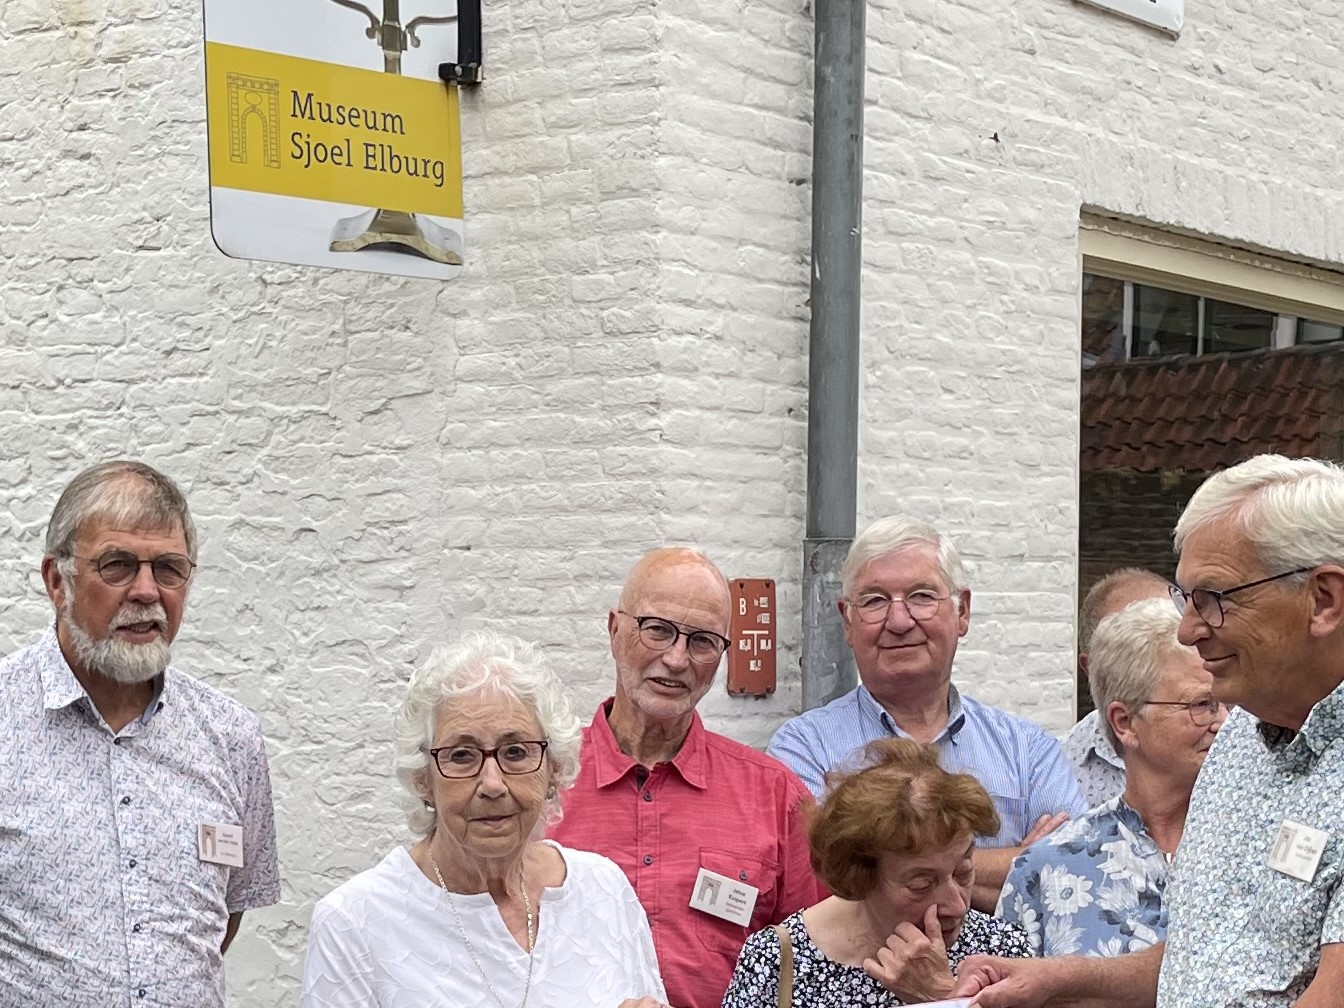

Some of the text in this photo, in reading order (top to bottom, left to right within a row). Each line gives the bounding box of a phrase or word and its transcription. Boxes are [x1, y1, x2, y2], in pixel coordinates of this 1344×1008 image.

[291, 90, 406, 135] Museum
[290, 131, 444, 188] Sjoel Elburg
